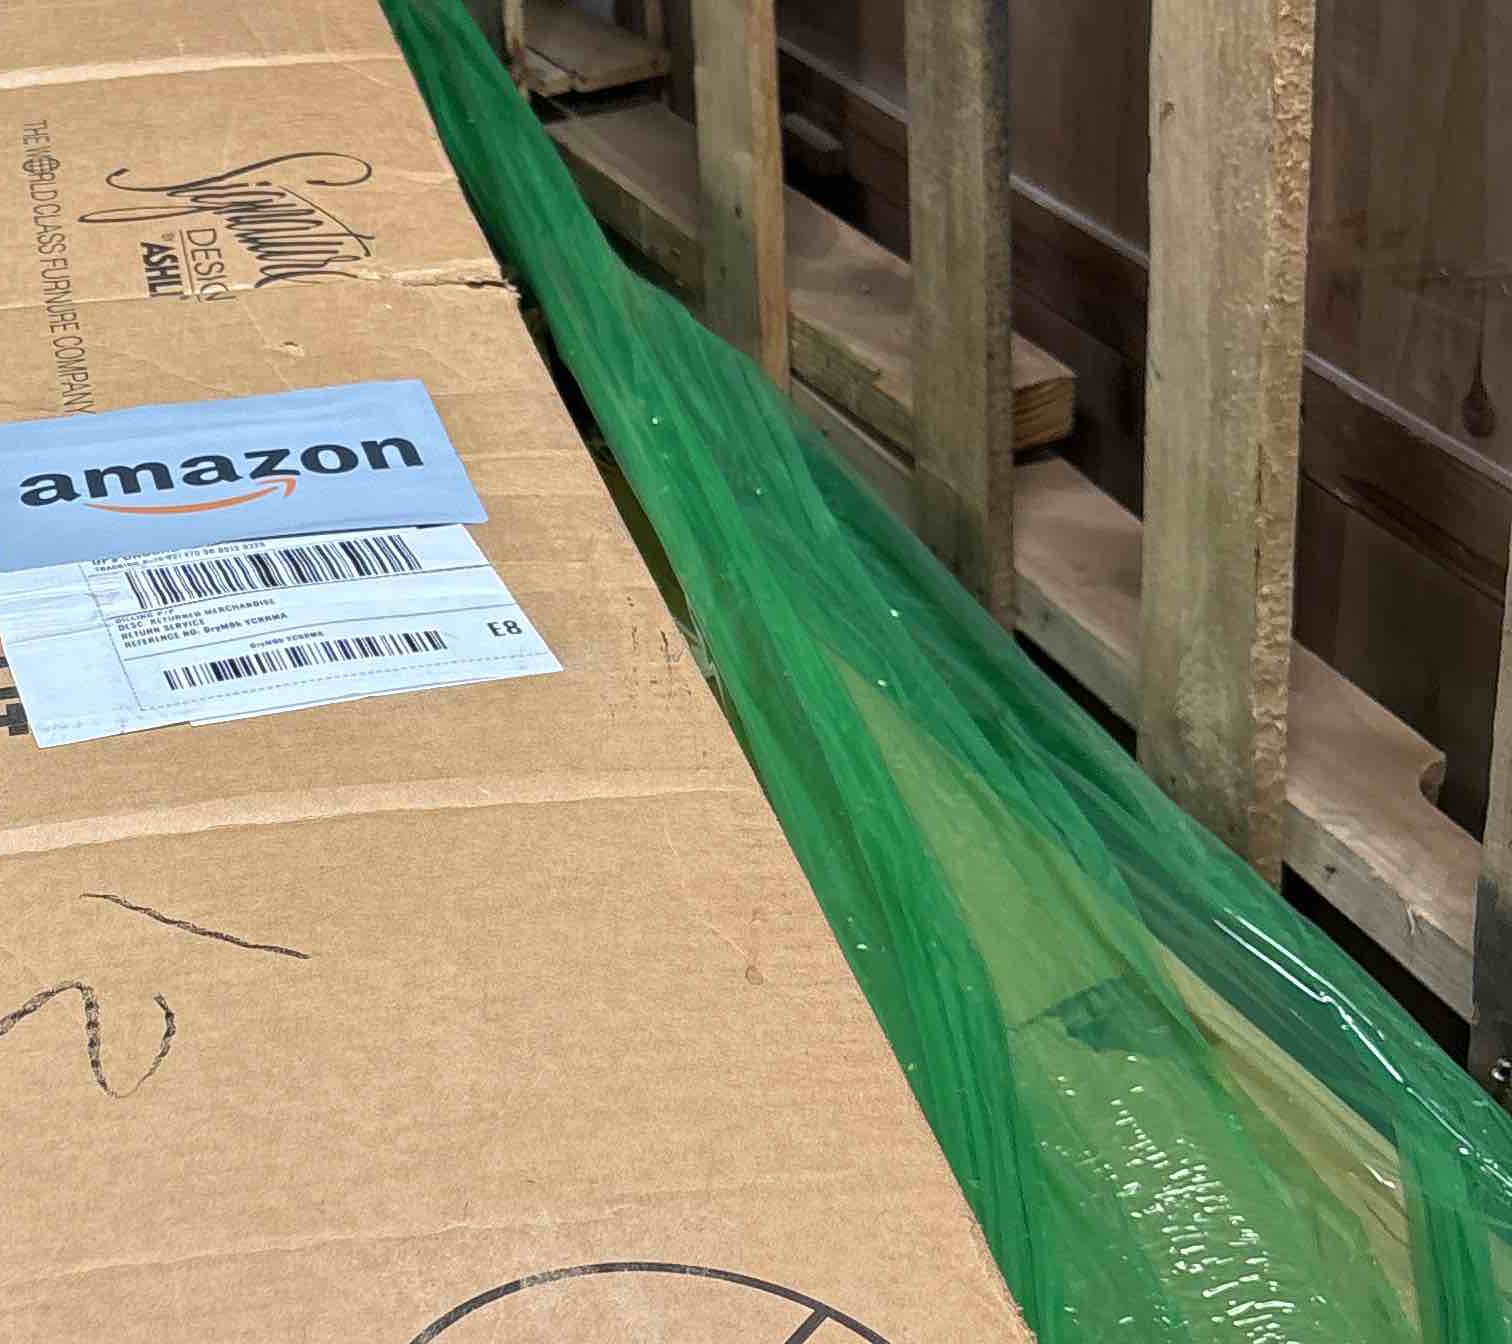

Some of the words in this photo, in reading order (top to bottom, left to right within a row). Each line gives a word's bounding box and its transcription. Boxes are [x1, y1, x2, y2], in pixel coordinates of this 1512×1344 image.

[23, 120, 50, 145] THE
[33, 203, 67, 255] CLASS
[53, 334, 96, 416] COMPANY
[20, 436, 424, 506] amazon
[487, 620, 522, 637] E8
